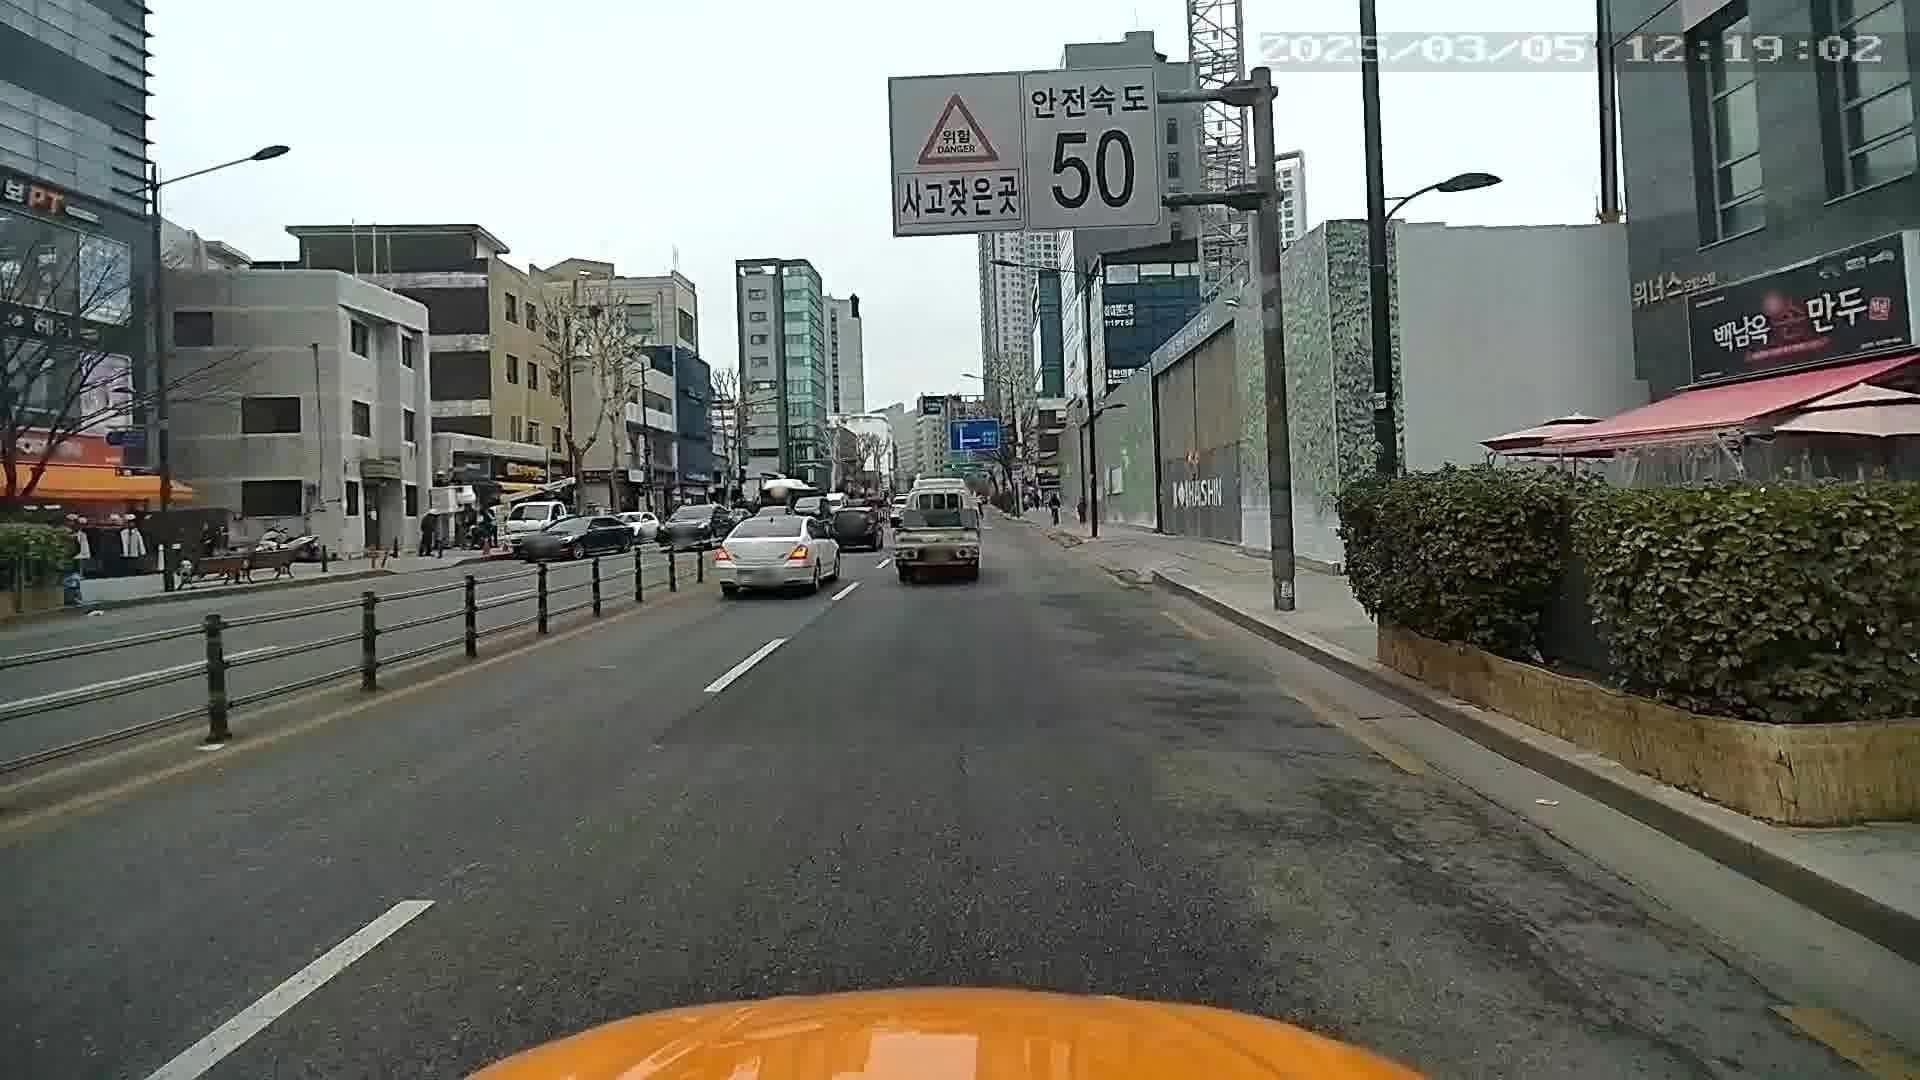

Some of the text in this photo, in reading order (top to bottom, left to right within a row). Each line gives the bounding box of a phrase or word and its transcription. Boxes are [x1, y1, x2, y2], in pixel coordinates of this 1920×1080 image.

[1031, 84, 1149, 119] 안전속도
[937, 143, 976, 155] DANGER
[943, 129, 971, 145] 위험
[1051, 128, 1135, 209] 50
[901, 175, 1018, 219] 사고잦은곳
[1713, 314, 1770, 353] 백남옥
[1806, 287, 1868, 333] 만두
